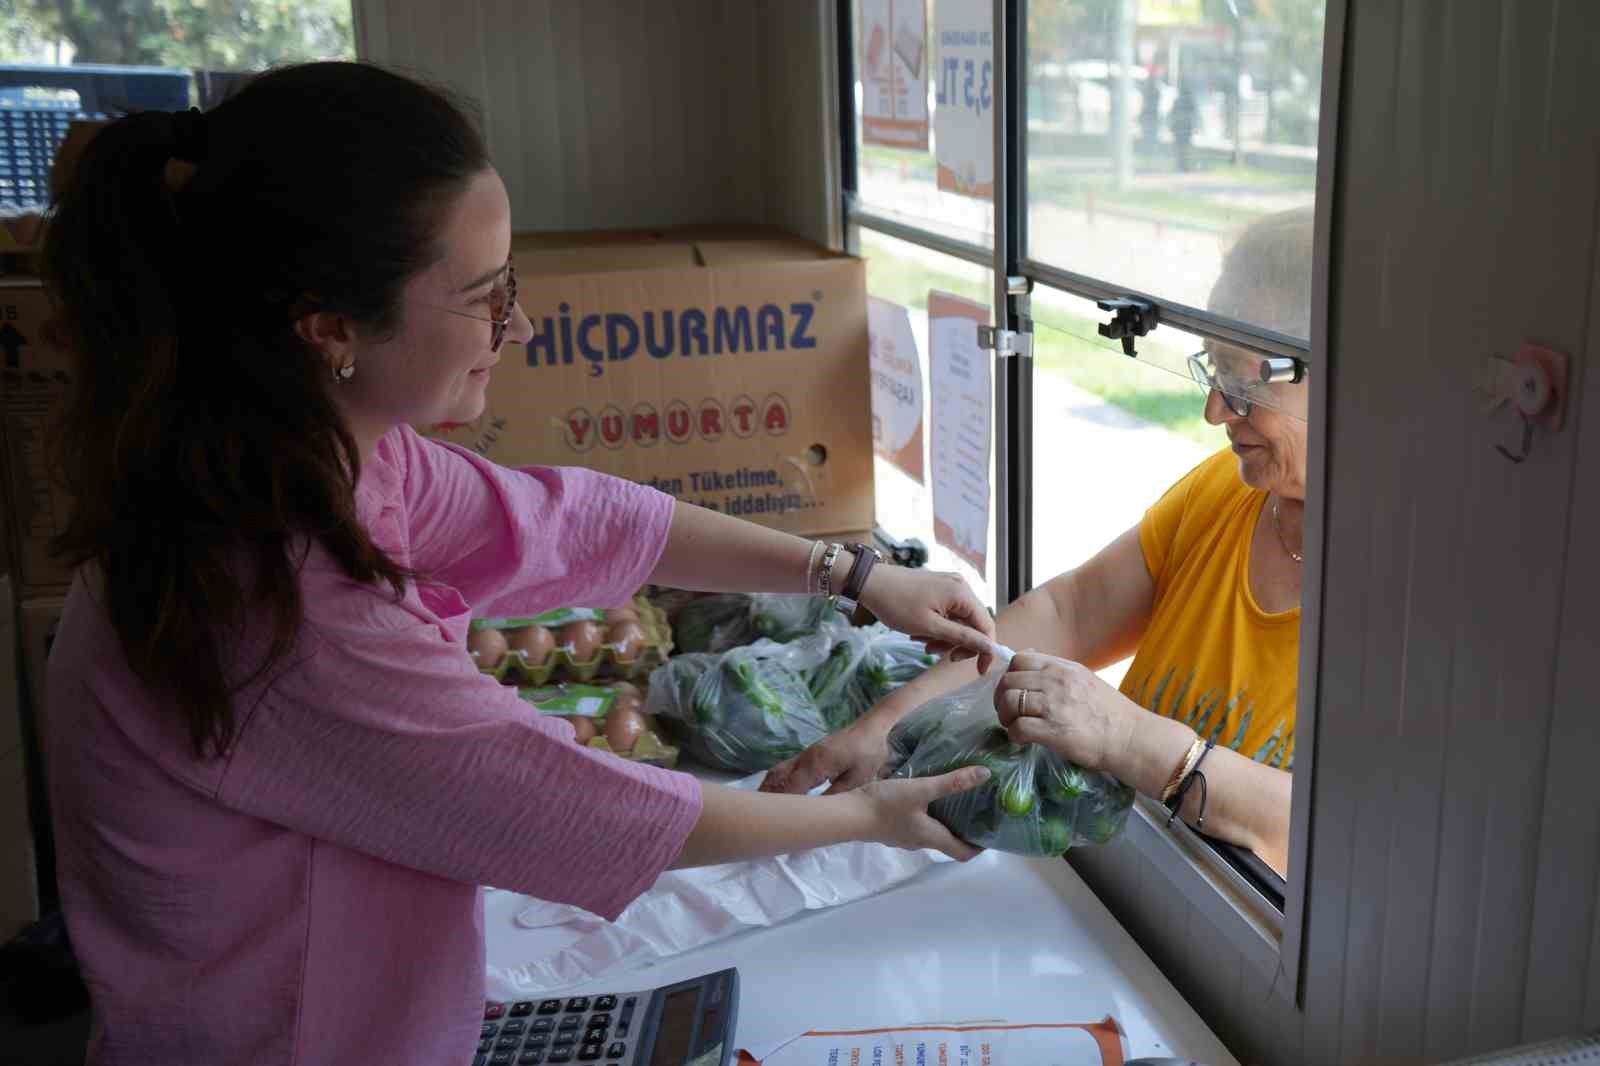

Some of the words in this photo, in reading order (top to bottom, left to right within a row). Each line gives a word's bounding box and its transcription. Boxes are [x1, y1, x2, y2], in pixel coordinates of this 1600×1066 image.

[525, 301, 817, 378] HİÇDURMAZ
[567, 402, 788, 445] YUMURTA
[689, 467, 784, 492] Tüketime,
